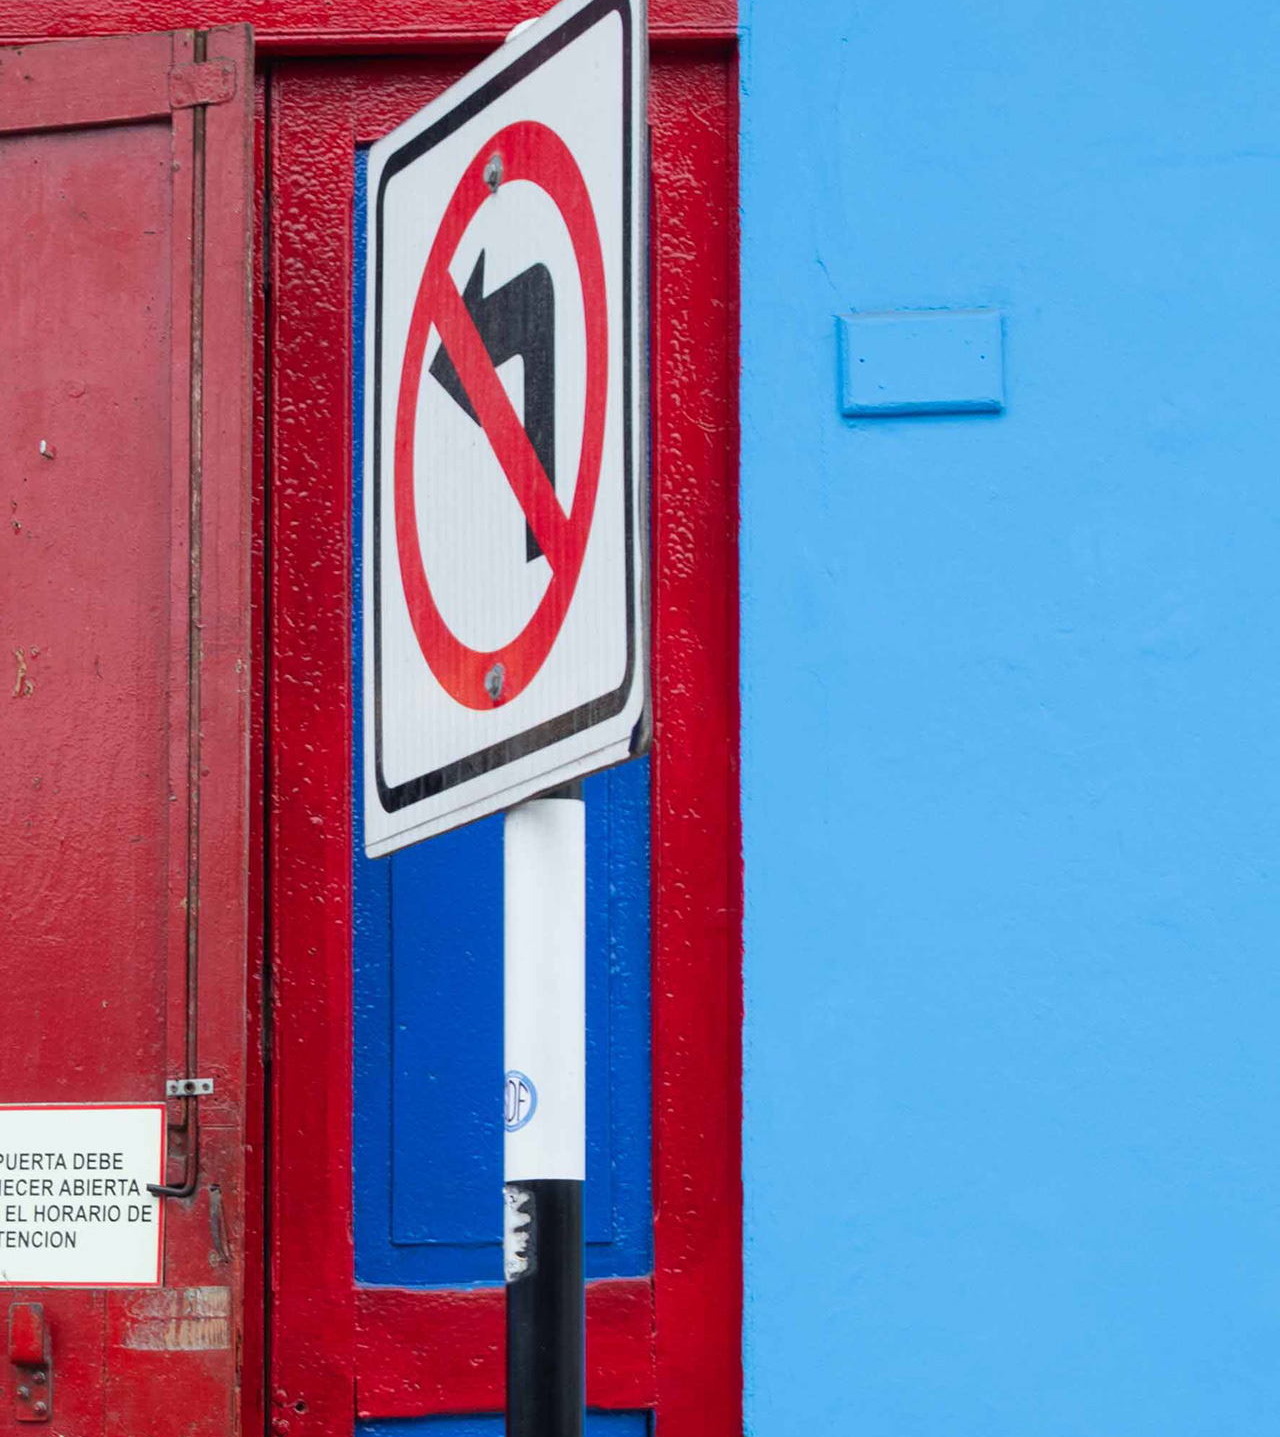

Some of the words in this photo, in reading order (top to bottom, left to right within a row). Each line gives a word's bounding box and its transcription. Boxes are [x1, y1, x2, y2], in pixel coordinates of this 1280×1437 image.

[73, 1152, 123, 1170] DEBE
[58, 1178, 141, 1197] ABIERTA
[5, 1204, 28, 1223] EL
[34, 1204, 121, 1223] HORARIO
[127, 1204, 153, 1223] DE
